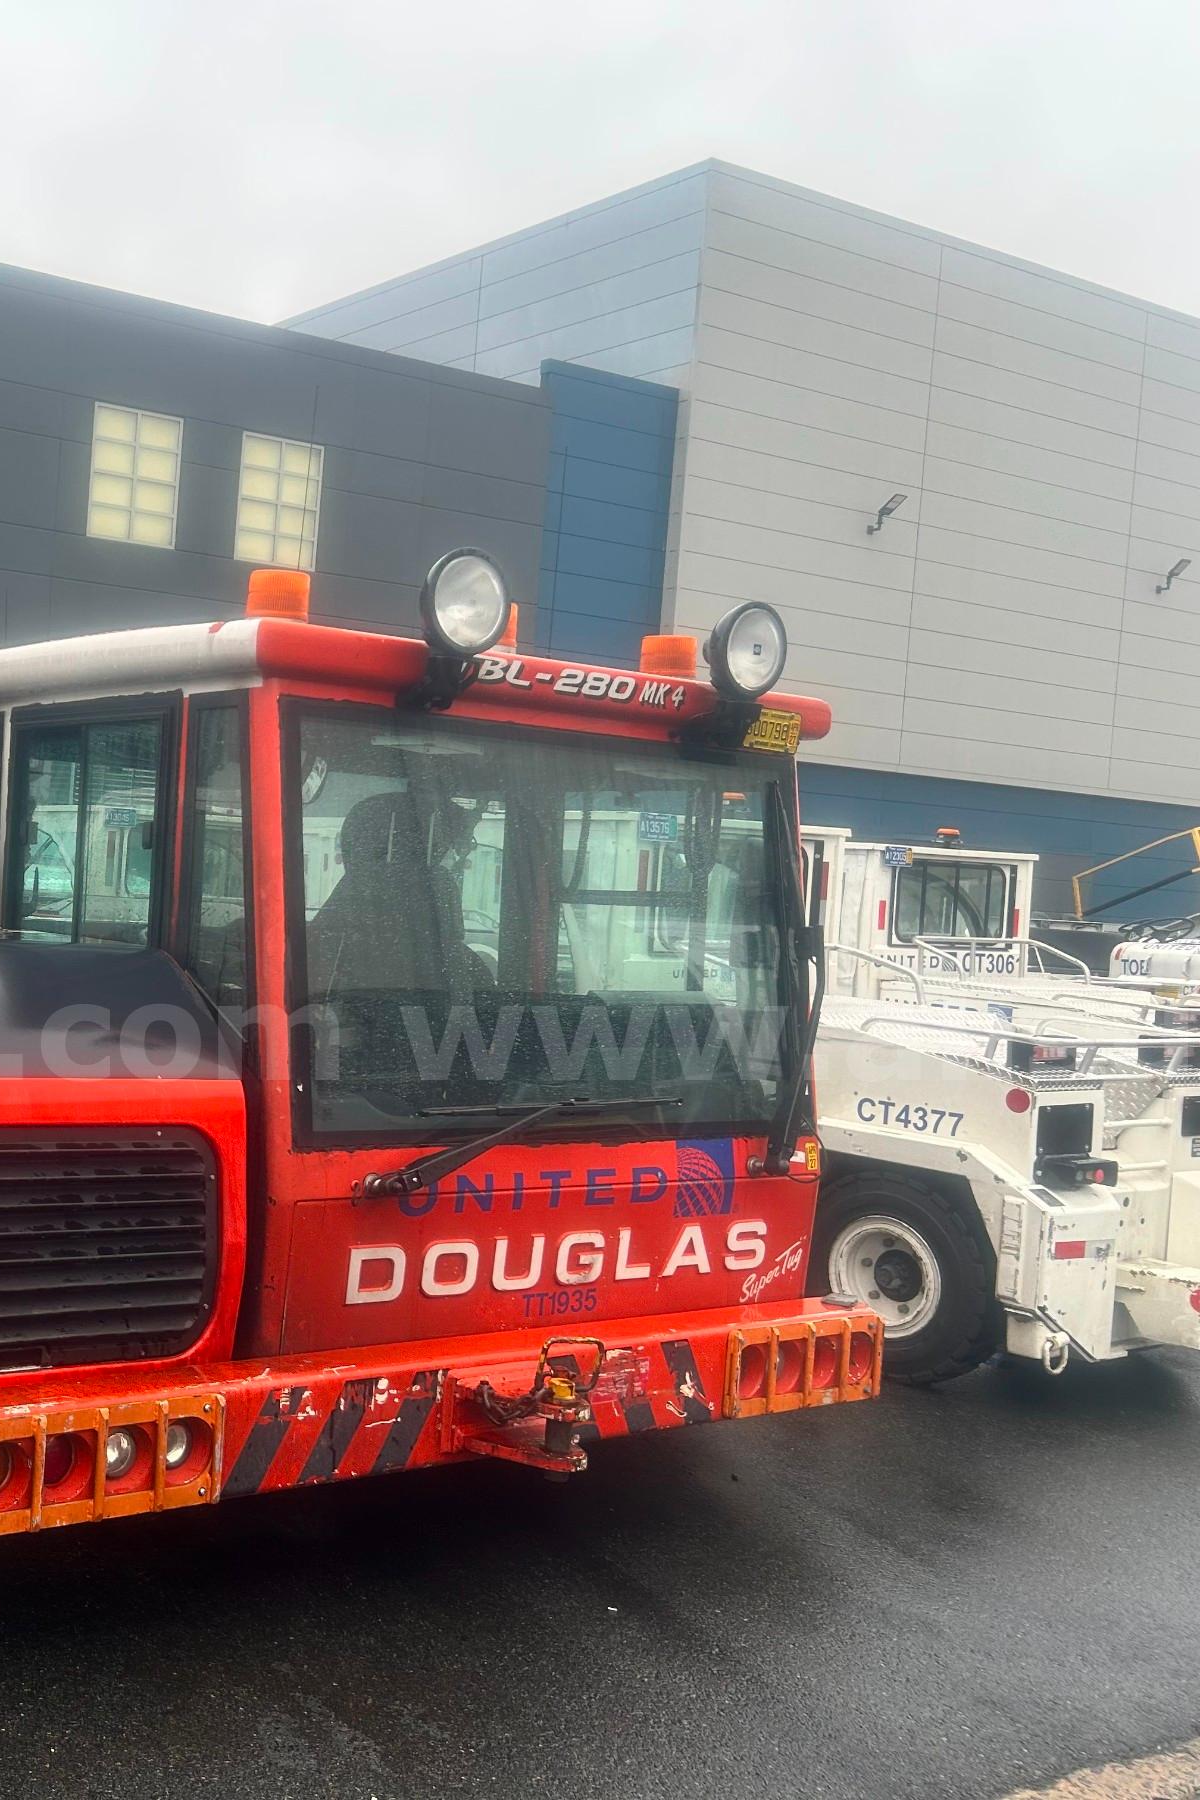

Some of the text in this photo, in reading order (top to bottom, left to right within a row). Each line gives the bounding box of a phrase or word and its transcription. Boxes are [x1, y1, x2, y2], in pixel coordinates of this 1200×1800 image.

[461, 657, 684, 707] BL-280 MK 4
[962, 952, 1021, 975] CT306
[857, 1096, 965, 1137] CT4377
[398, 1166, 669, 1217] UNITED
[345, 1218, 767, 1305] DOUGLAS
[521, 1287, 598, 1319] TT1935
[739, 1264, 781, 1303] Super
